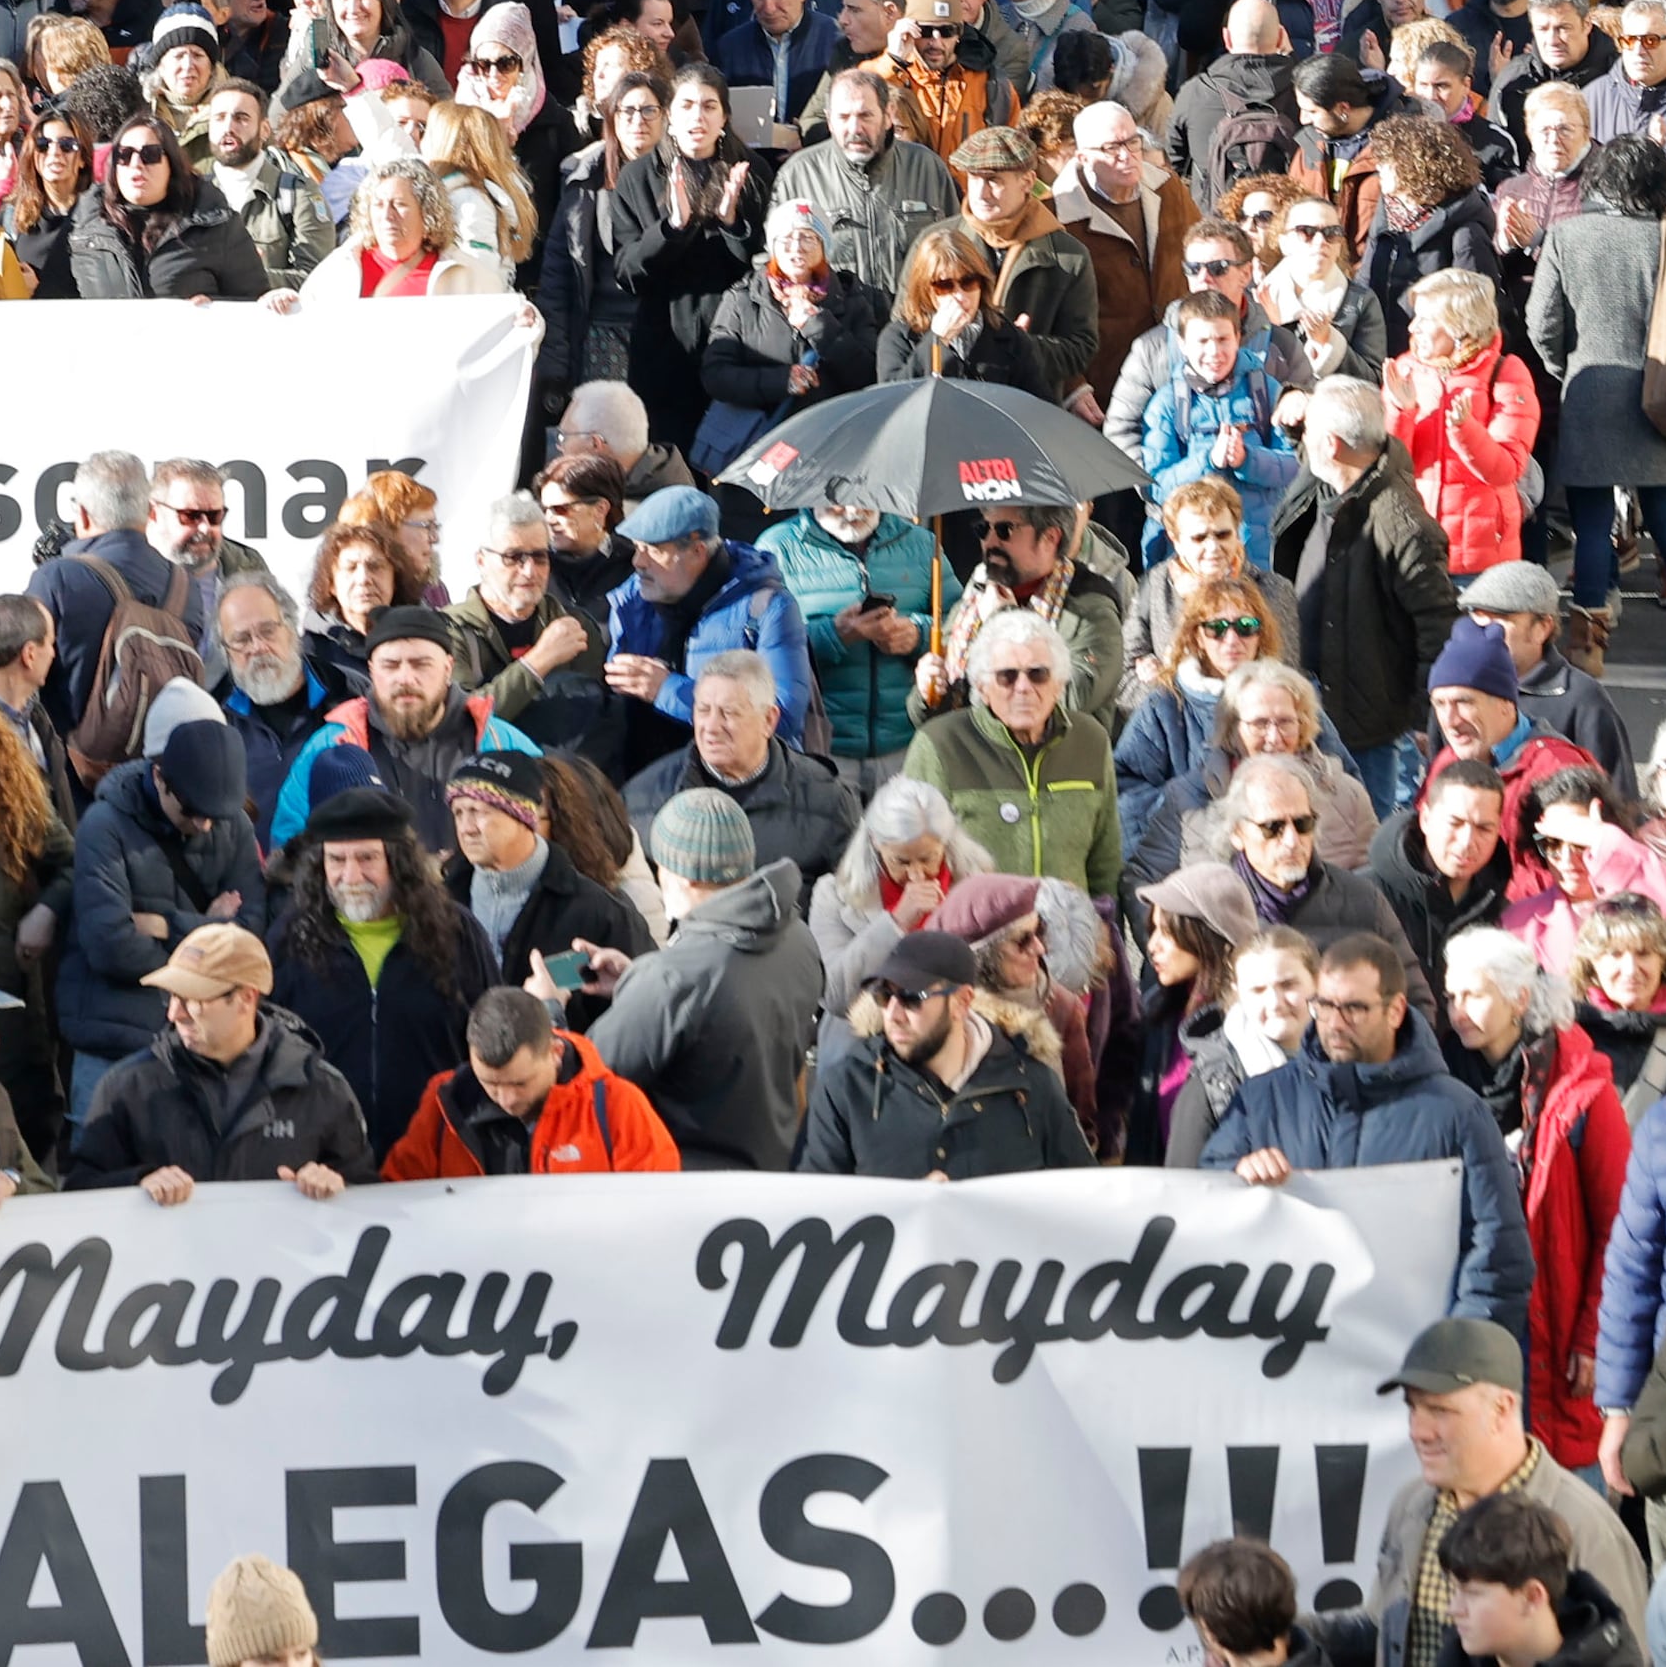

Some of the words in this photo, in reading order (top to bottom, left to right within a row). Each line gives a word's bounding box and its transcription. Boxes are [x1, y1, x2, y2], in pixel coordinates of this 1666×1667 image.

[958, 457, 1019, 484] ALTRI
[961, 478, 1022, 501] NON
[695, 1214, 1336, 1385] Mayday
